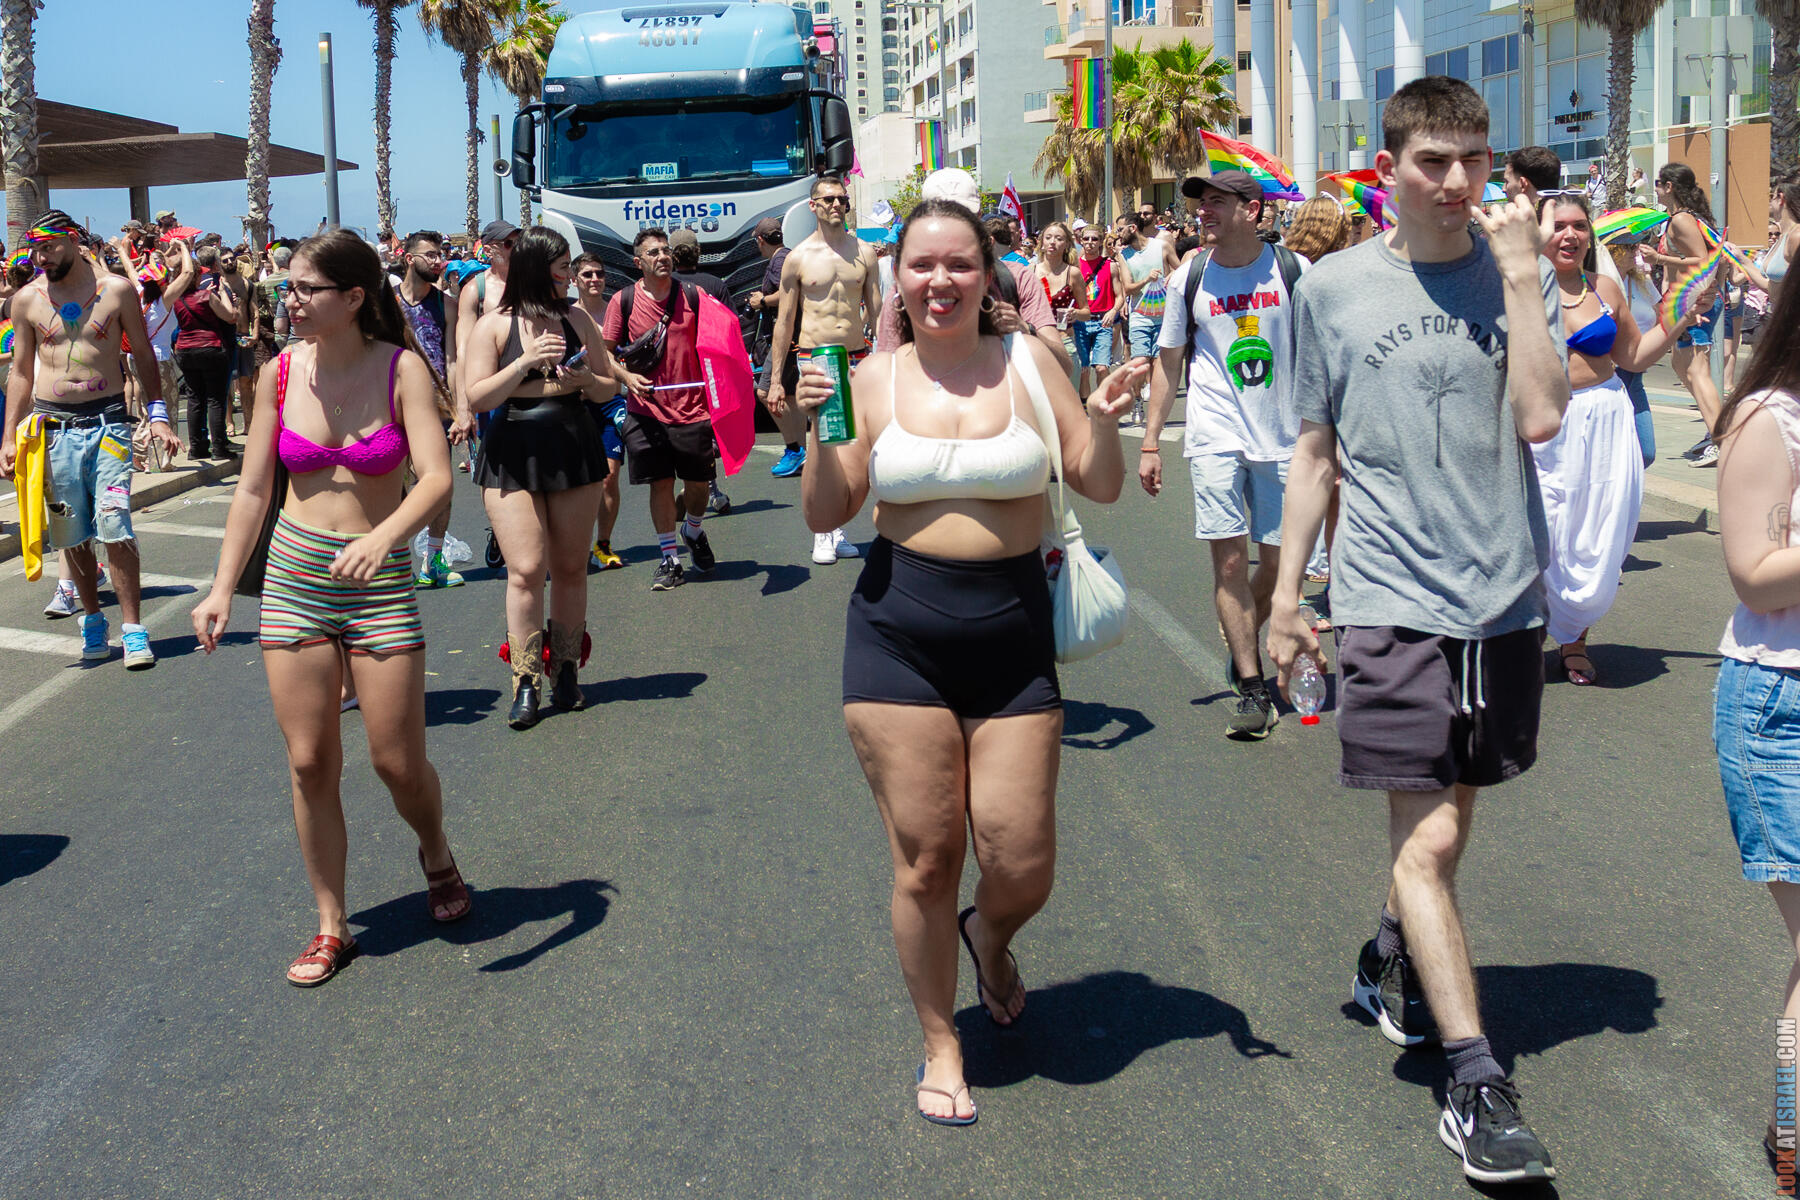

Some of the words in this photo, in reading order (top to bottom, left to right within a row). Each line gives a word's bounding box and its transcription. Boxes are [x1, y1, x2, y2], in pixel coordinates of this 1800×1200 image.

[645, 165, 675, 175] MAFIA
[623, 199, 737, 220] fridenson
[1209, 291, 1280, 317] MARVIN
[1364, 323, 1413, 370] RAYS
[1420, 314, 1459, 335] FOR
